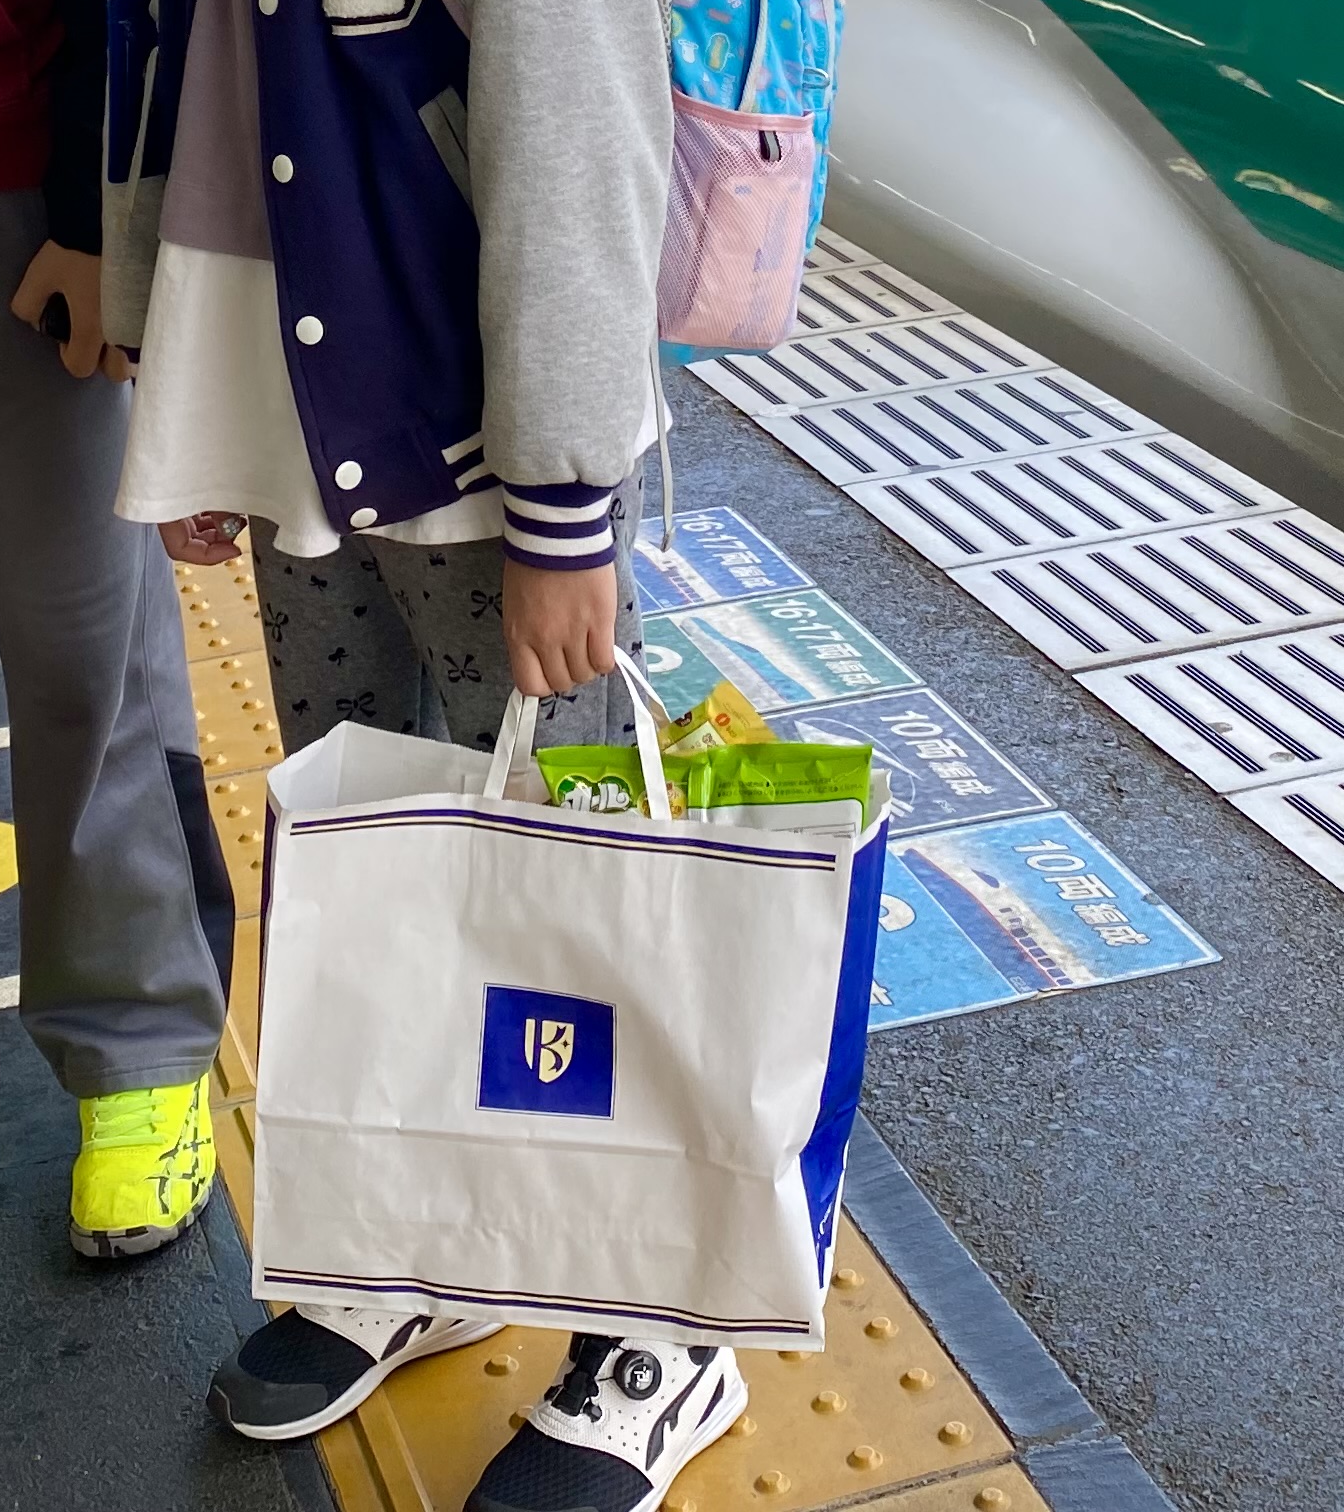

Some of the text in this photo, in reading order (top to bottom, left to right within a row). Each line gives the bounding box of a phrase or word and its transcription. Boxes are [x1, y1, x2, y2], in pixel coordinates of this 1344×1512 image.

[879, 709, 996, 796] 10両編成
[1011, 838, 1152, 947] 10両編成
